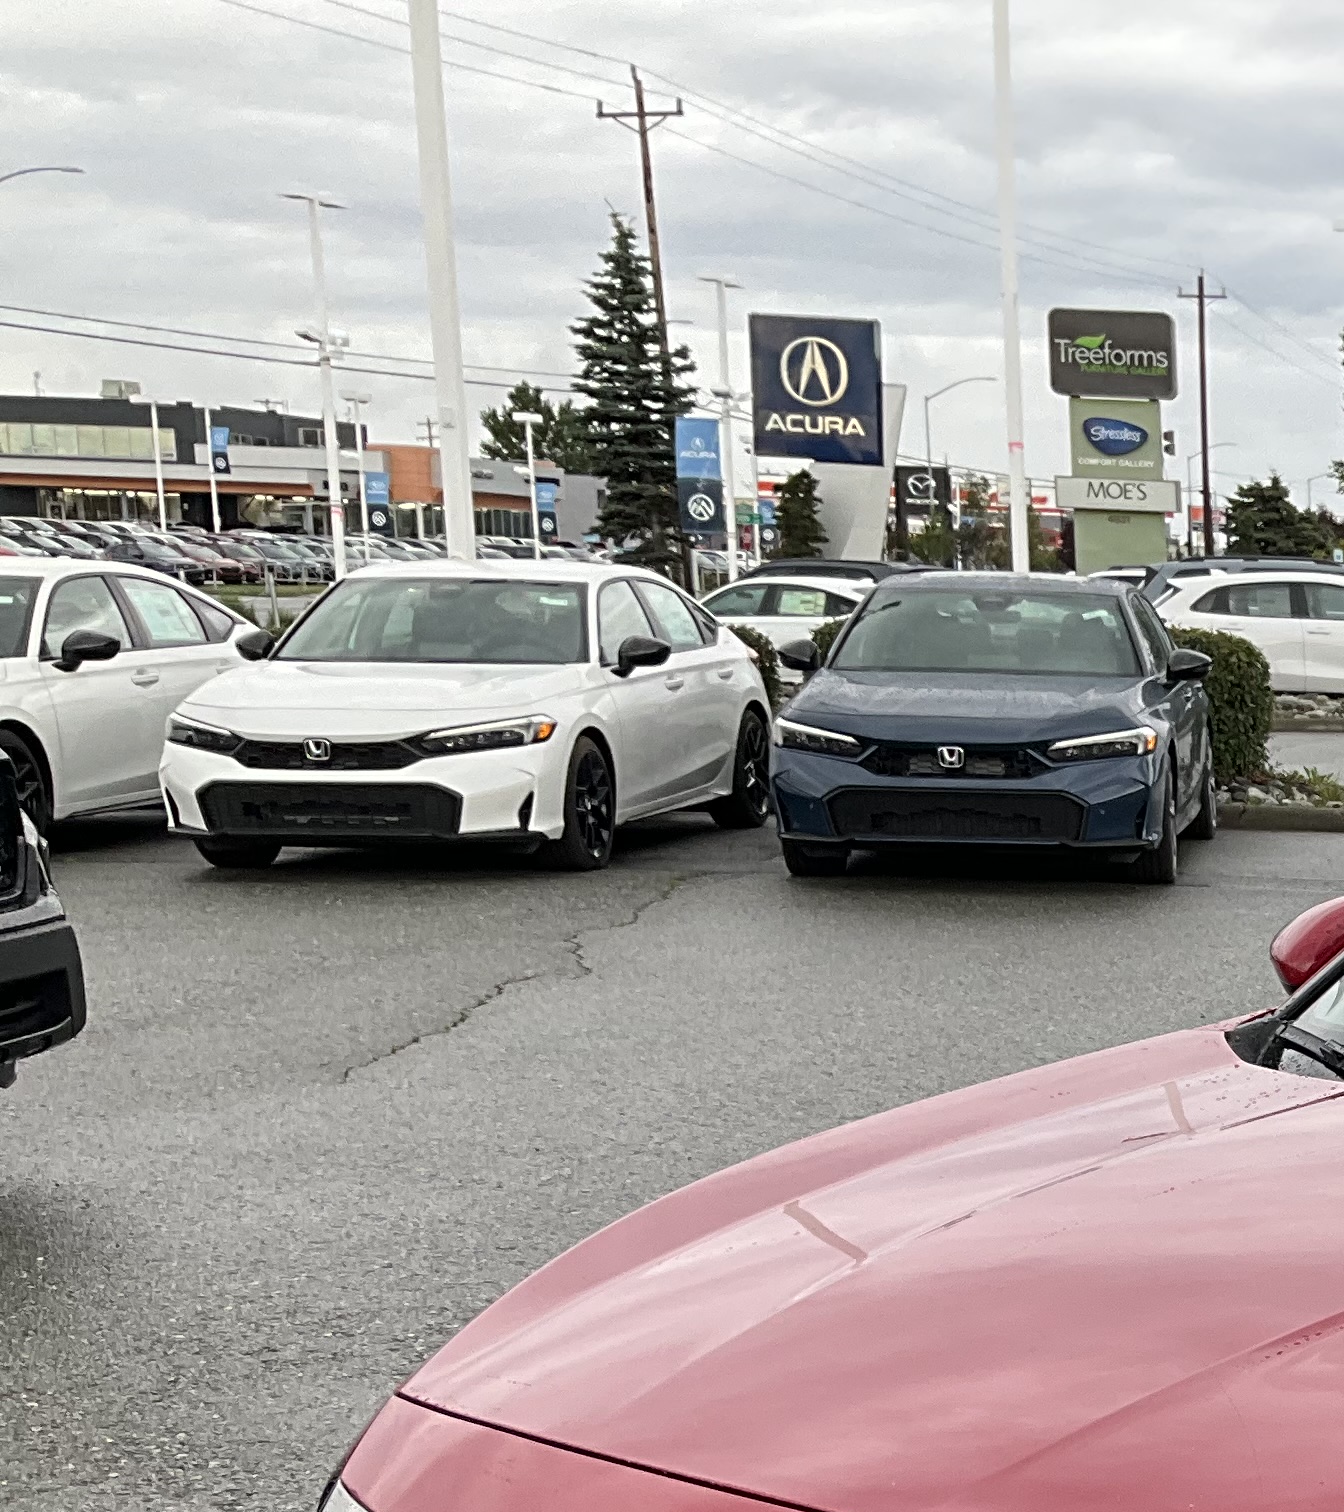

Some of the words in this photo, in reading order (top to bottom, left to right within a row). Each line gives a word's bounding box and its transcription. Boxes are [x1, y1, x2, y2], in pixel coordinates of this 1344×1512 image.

[1053, 338, 1169, 368] Treeforms
[765, 413, 866, 437] ACURA
[1090, 425, 1141, 442] Stressless
[1086, 481, 1147, 501] MOE'S
